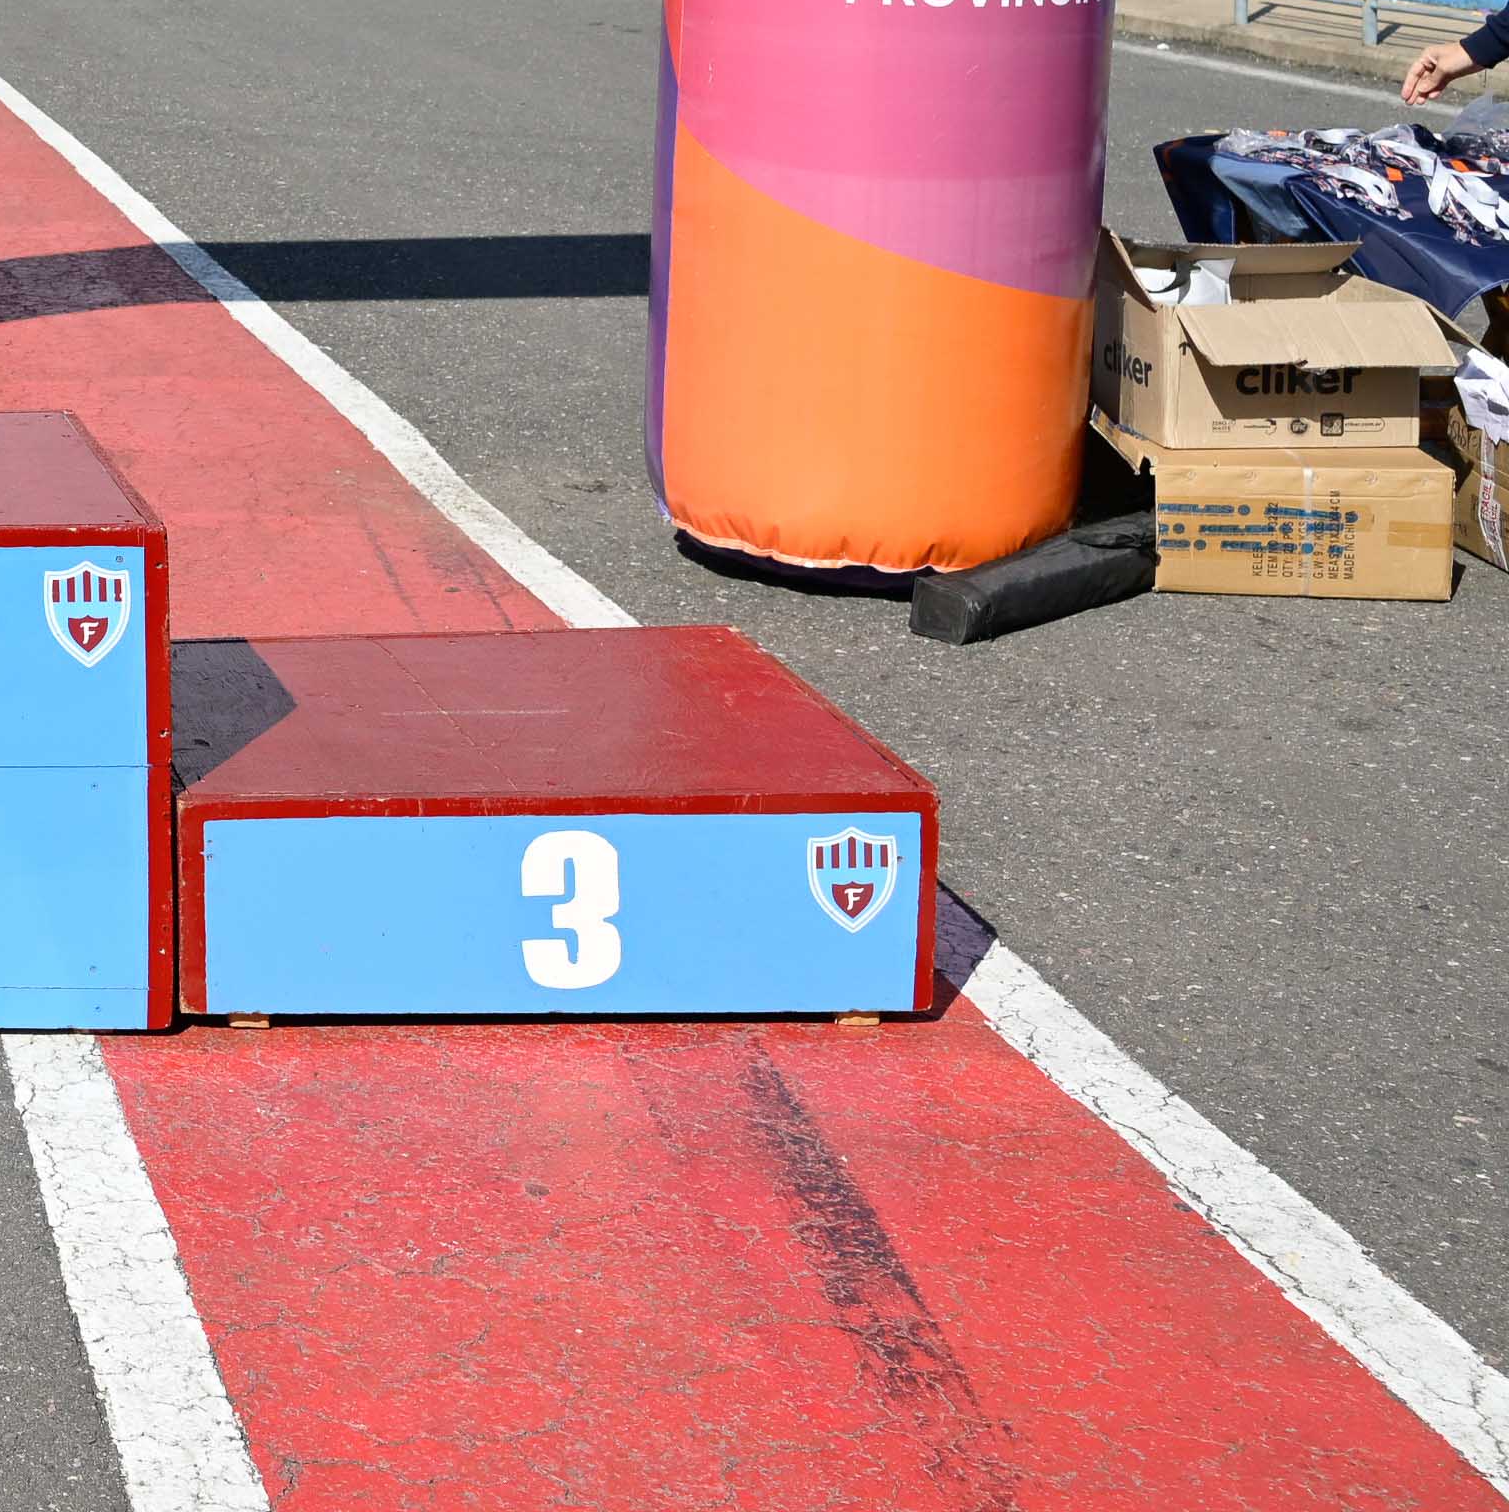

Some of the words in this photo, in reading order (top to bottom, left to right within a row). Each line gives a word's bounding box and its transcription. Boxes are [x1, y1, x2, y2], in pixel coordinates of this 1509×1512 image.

[1103, 341, 1153, 388] cliker
[1235, 363, 1363, 397] cliker
[519, 829, 622, 990] 3
